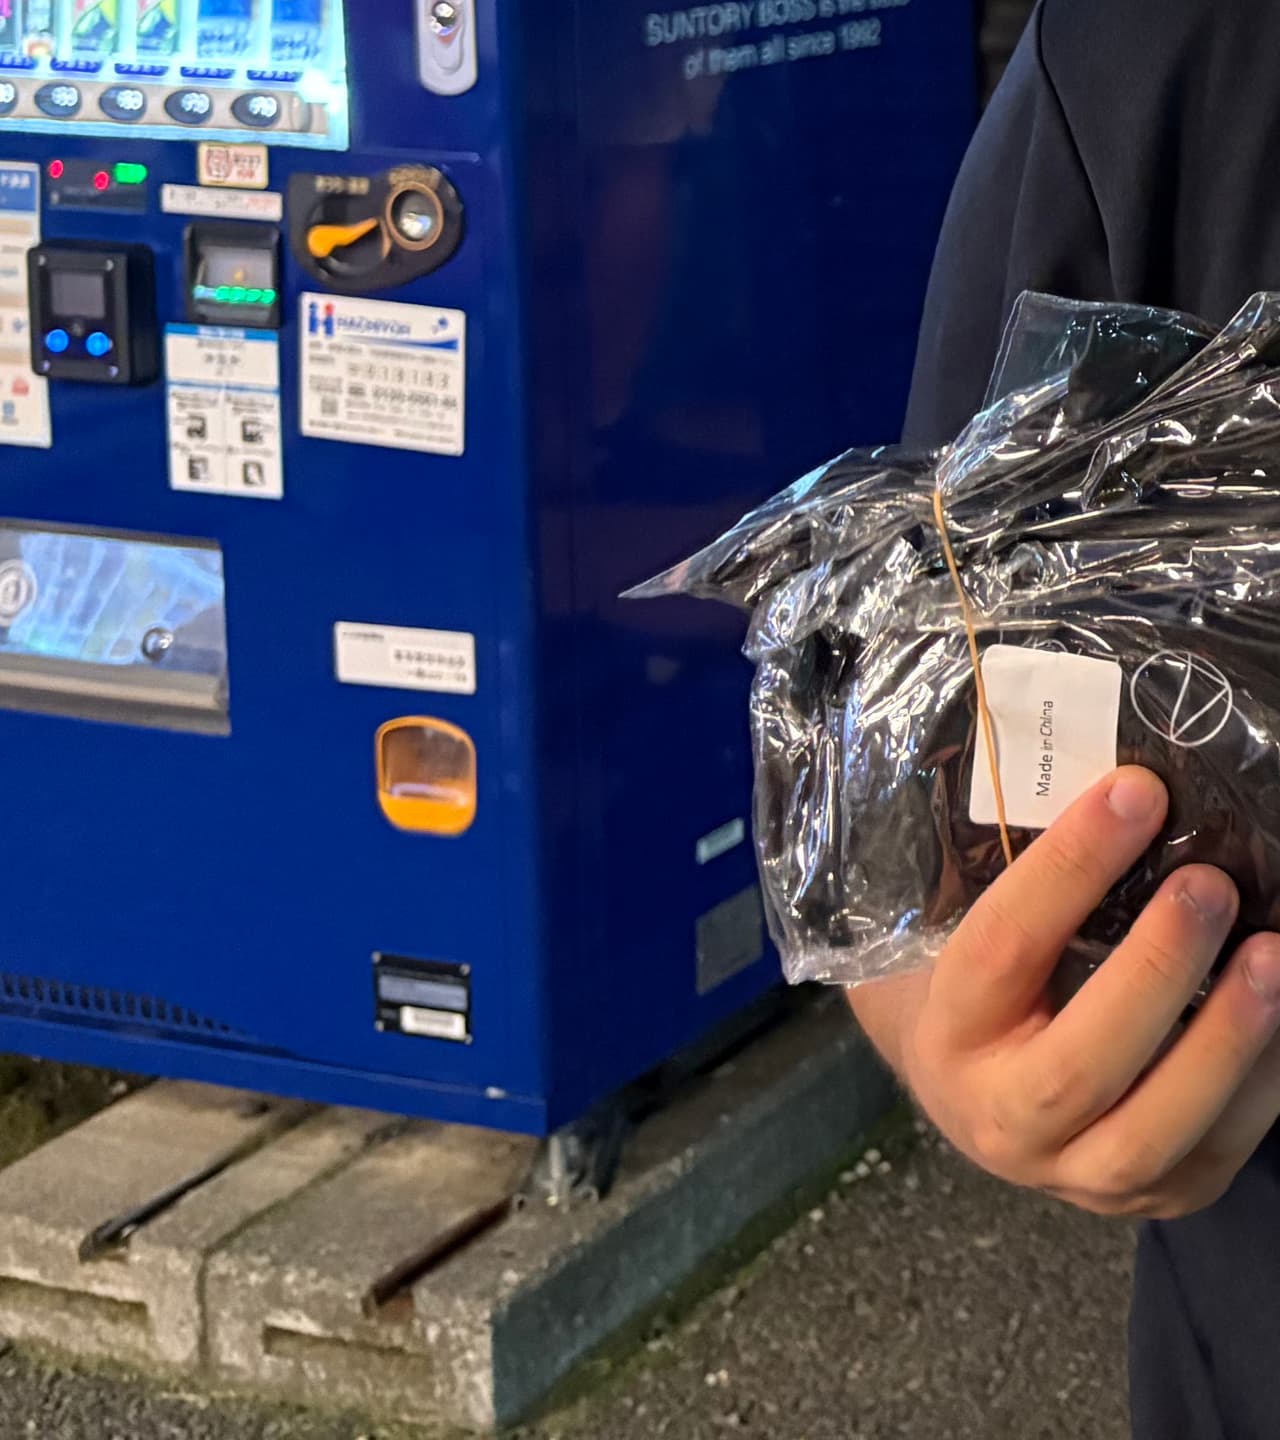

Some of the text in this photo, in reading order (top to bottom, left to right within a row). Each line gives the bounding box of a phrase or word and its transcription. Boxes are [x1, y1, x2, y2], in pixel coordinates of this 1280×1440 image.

[645, 0, 755, 47] SUNTORY
[1036, 700, 1054, 797] Made in China
